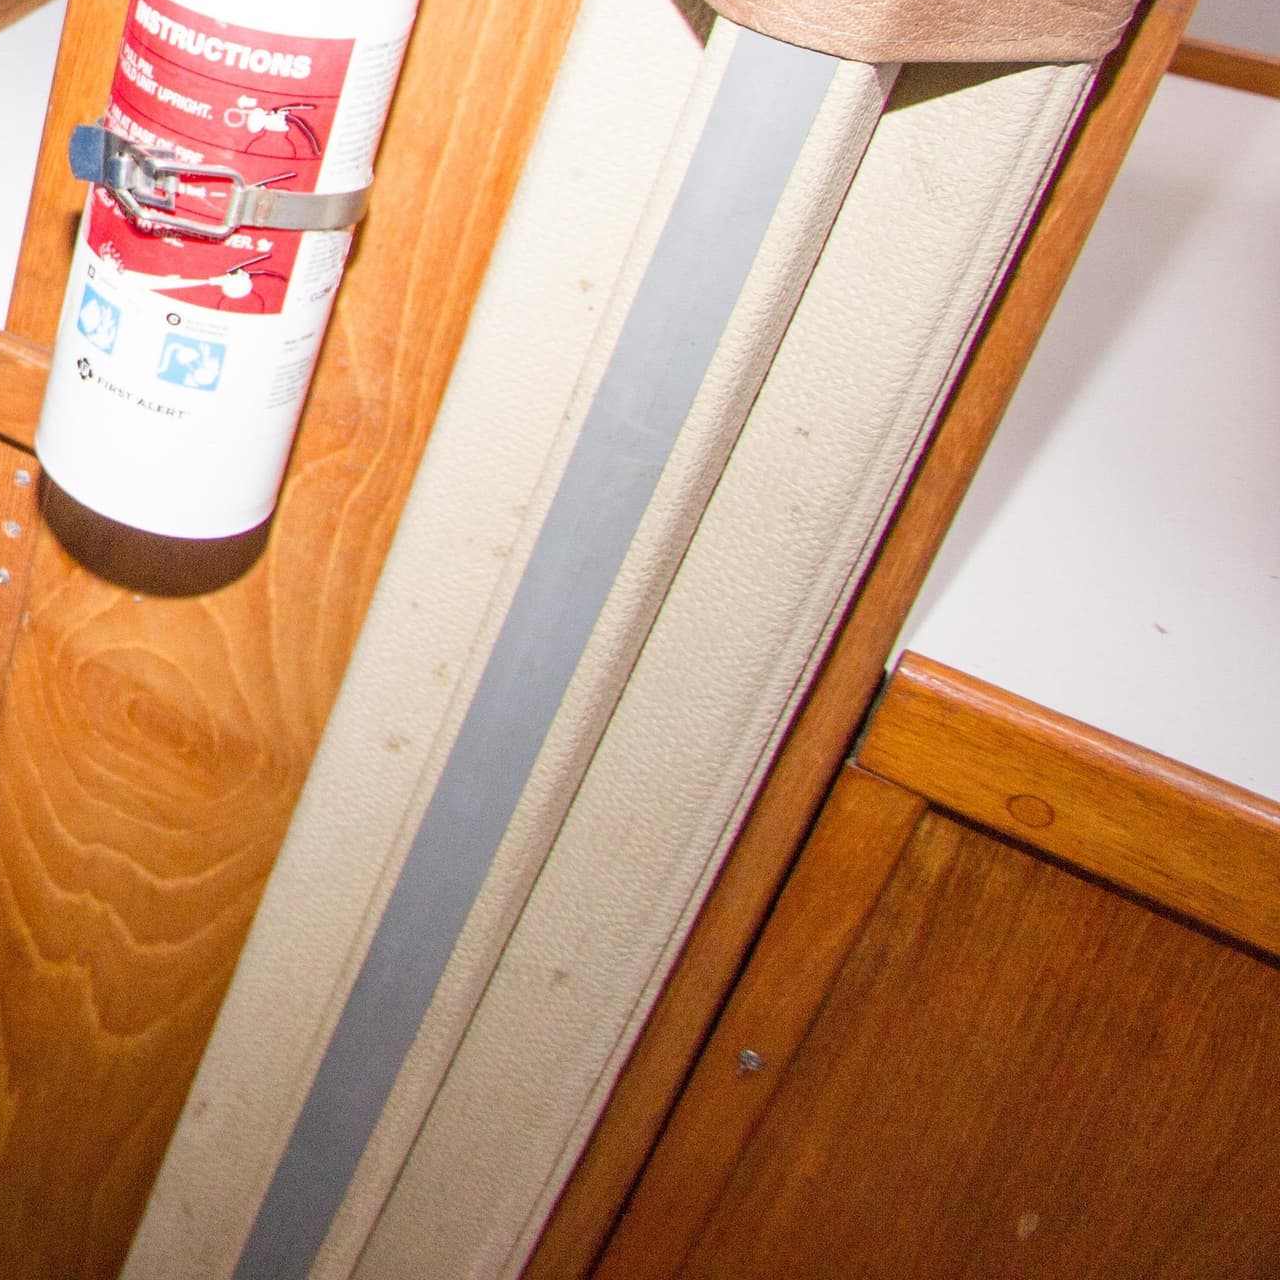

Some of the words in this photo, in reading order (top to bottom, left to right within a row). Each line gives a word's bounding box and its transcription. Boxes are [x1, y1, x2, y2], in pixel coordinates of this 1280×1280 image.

[136, 0, 312, 80] INSTRUCTIONS
[136, 74, 159, 95] UNIT
[157, 86, 213, 121] UPRIGHT.
[97, 375, 134, 400] FIRST
[137, 397, 187, 420] ALERT
